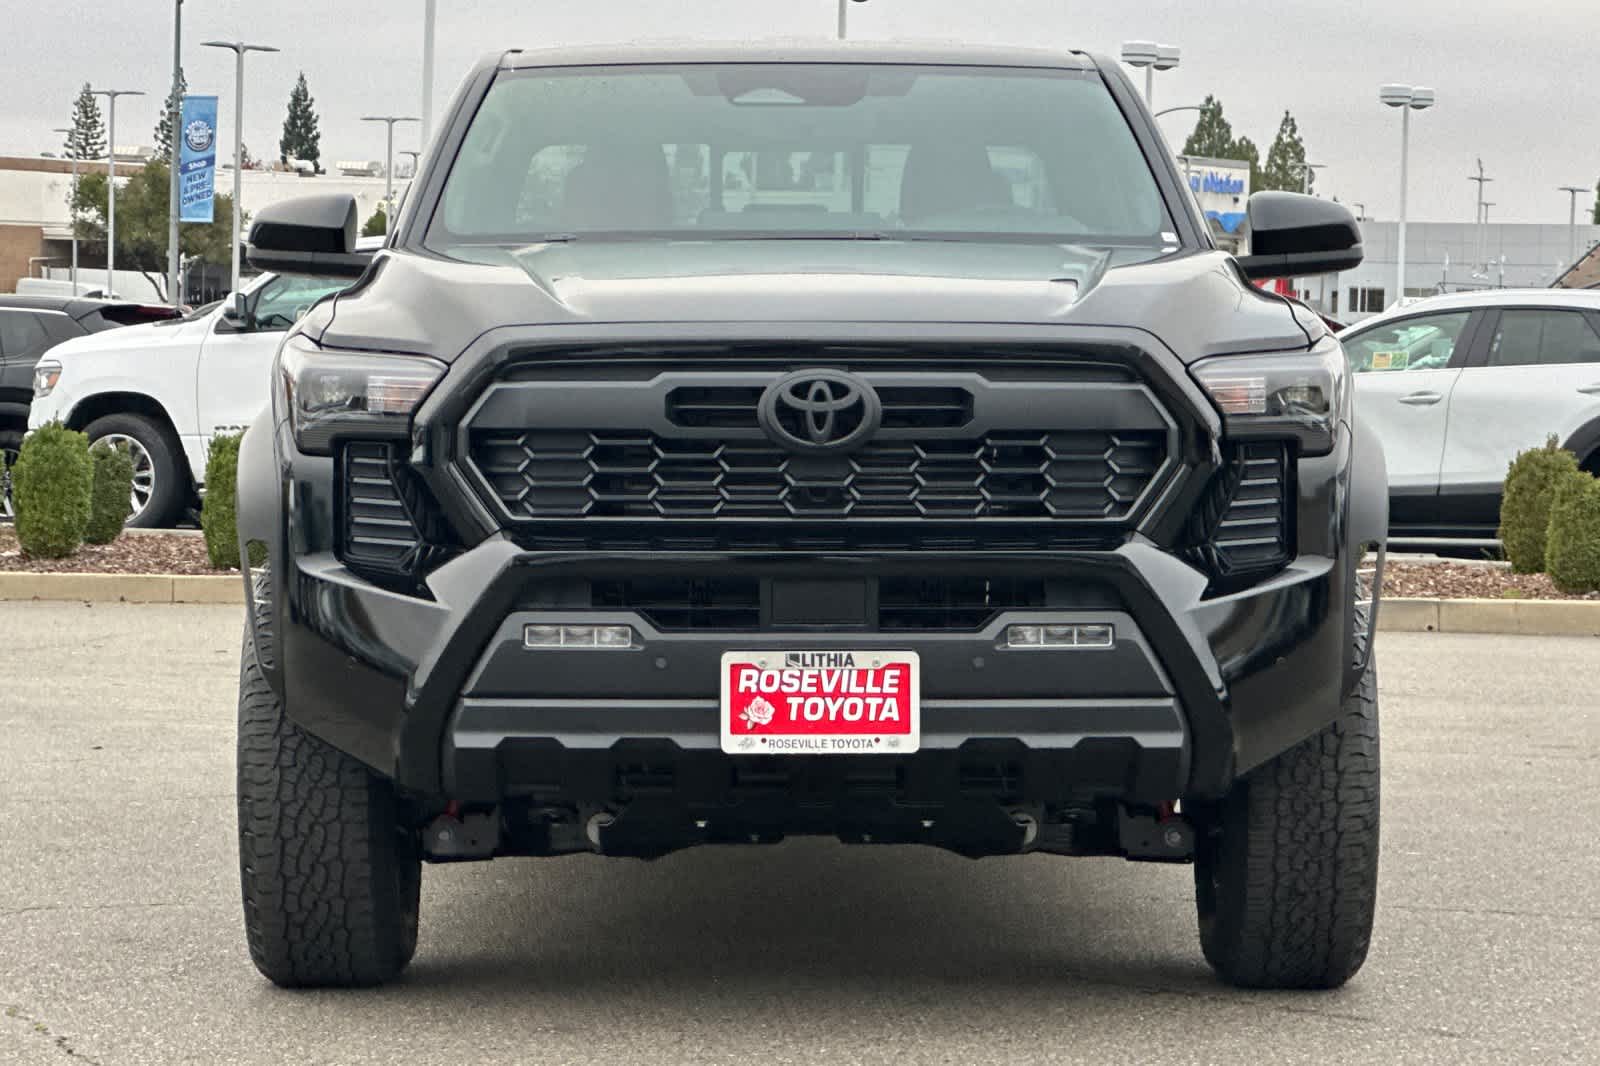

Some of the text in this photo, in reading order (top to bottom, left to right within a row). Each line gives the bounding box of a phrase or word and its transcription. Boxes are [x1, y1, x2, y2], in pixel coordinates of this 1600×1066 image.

[186, 170, 207, 184] NEW
[182, 189, 213, 205] OWNED
[801, 653, 855, 667] LITHIA
[738, 668, 900, 693] ROSEVILLE
[786, 696, 900, 721] TOYOTA
[768, 738, 874, 749] ROSEVILLE TOYOTA
